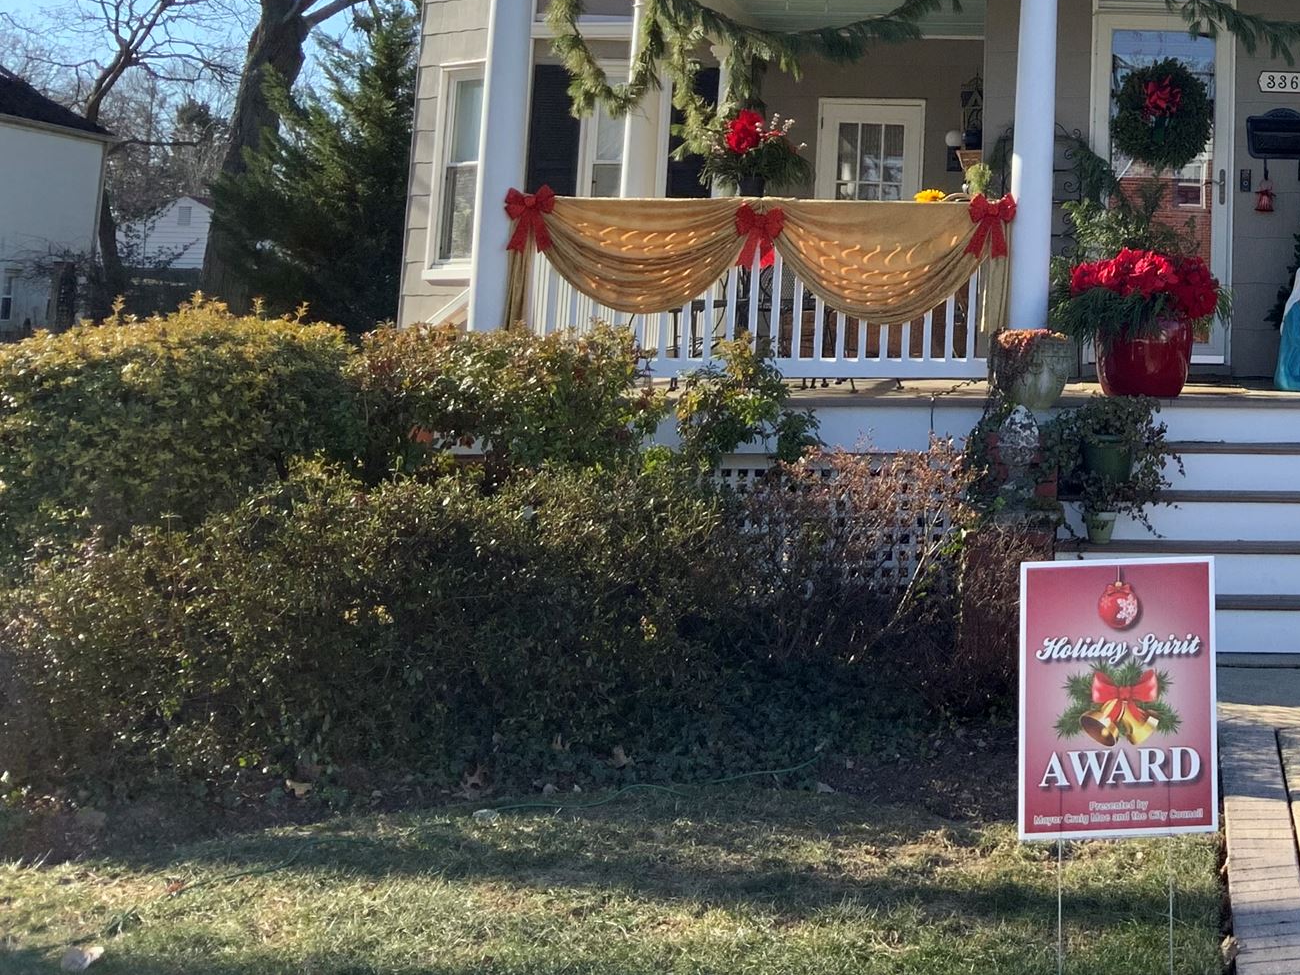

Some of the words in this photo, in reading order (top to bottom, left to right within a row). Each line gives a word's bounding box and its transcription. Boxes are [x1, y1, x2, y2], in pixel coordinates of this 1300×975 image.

[1266, 75, 1298, 89] 336
[1036, 636, 1127, 664] Holiday
[1133, 633, 1201, 663] Spirit
[1038, 746, 1201, 787] AWARD
[1089, 800, 1136, 811] Presented
[1137, 799, 1149, 810] by
[1034, 815, 1063, 826] Mayor
[1112, 811, 1130, 821] and
[1131, 810, 1147, 820] the
[1148, 810, 1168, 821] City
[1170, 808, 1203, 819] Council
